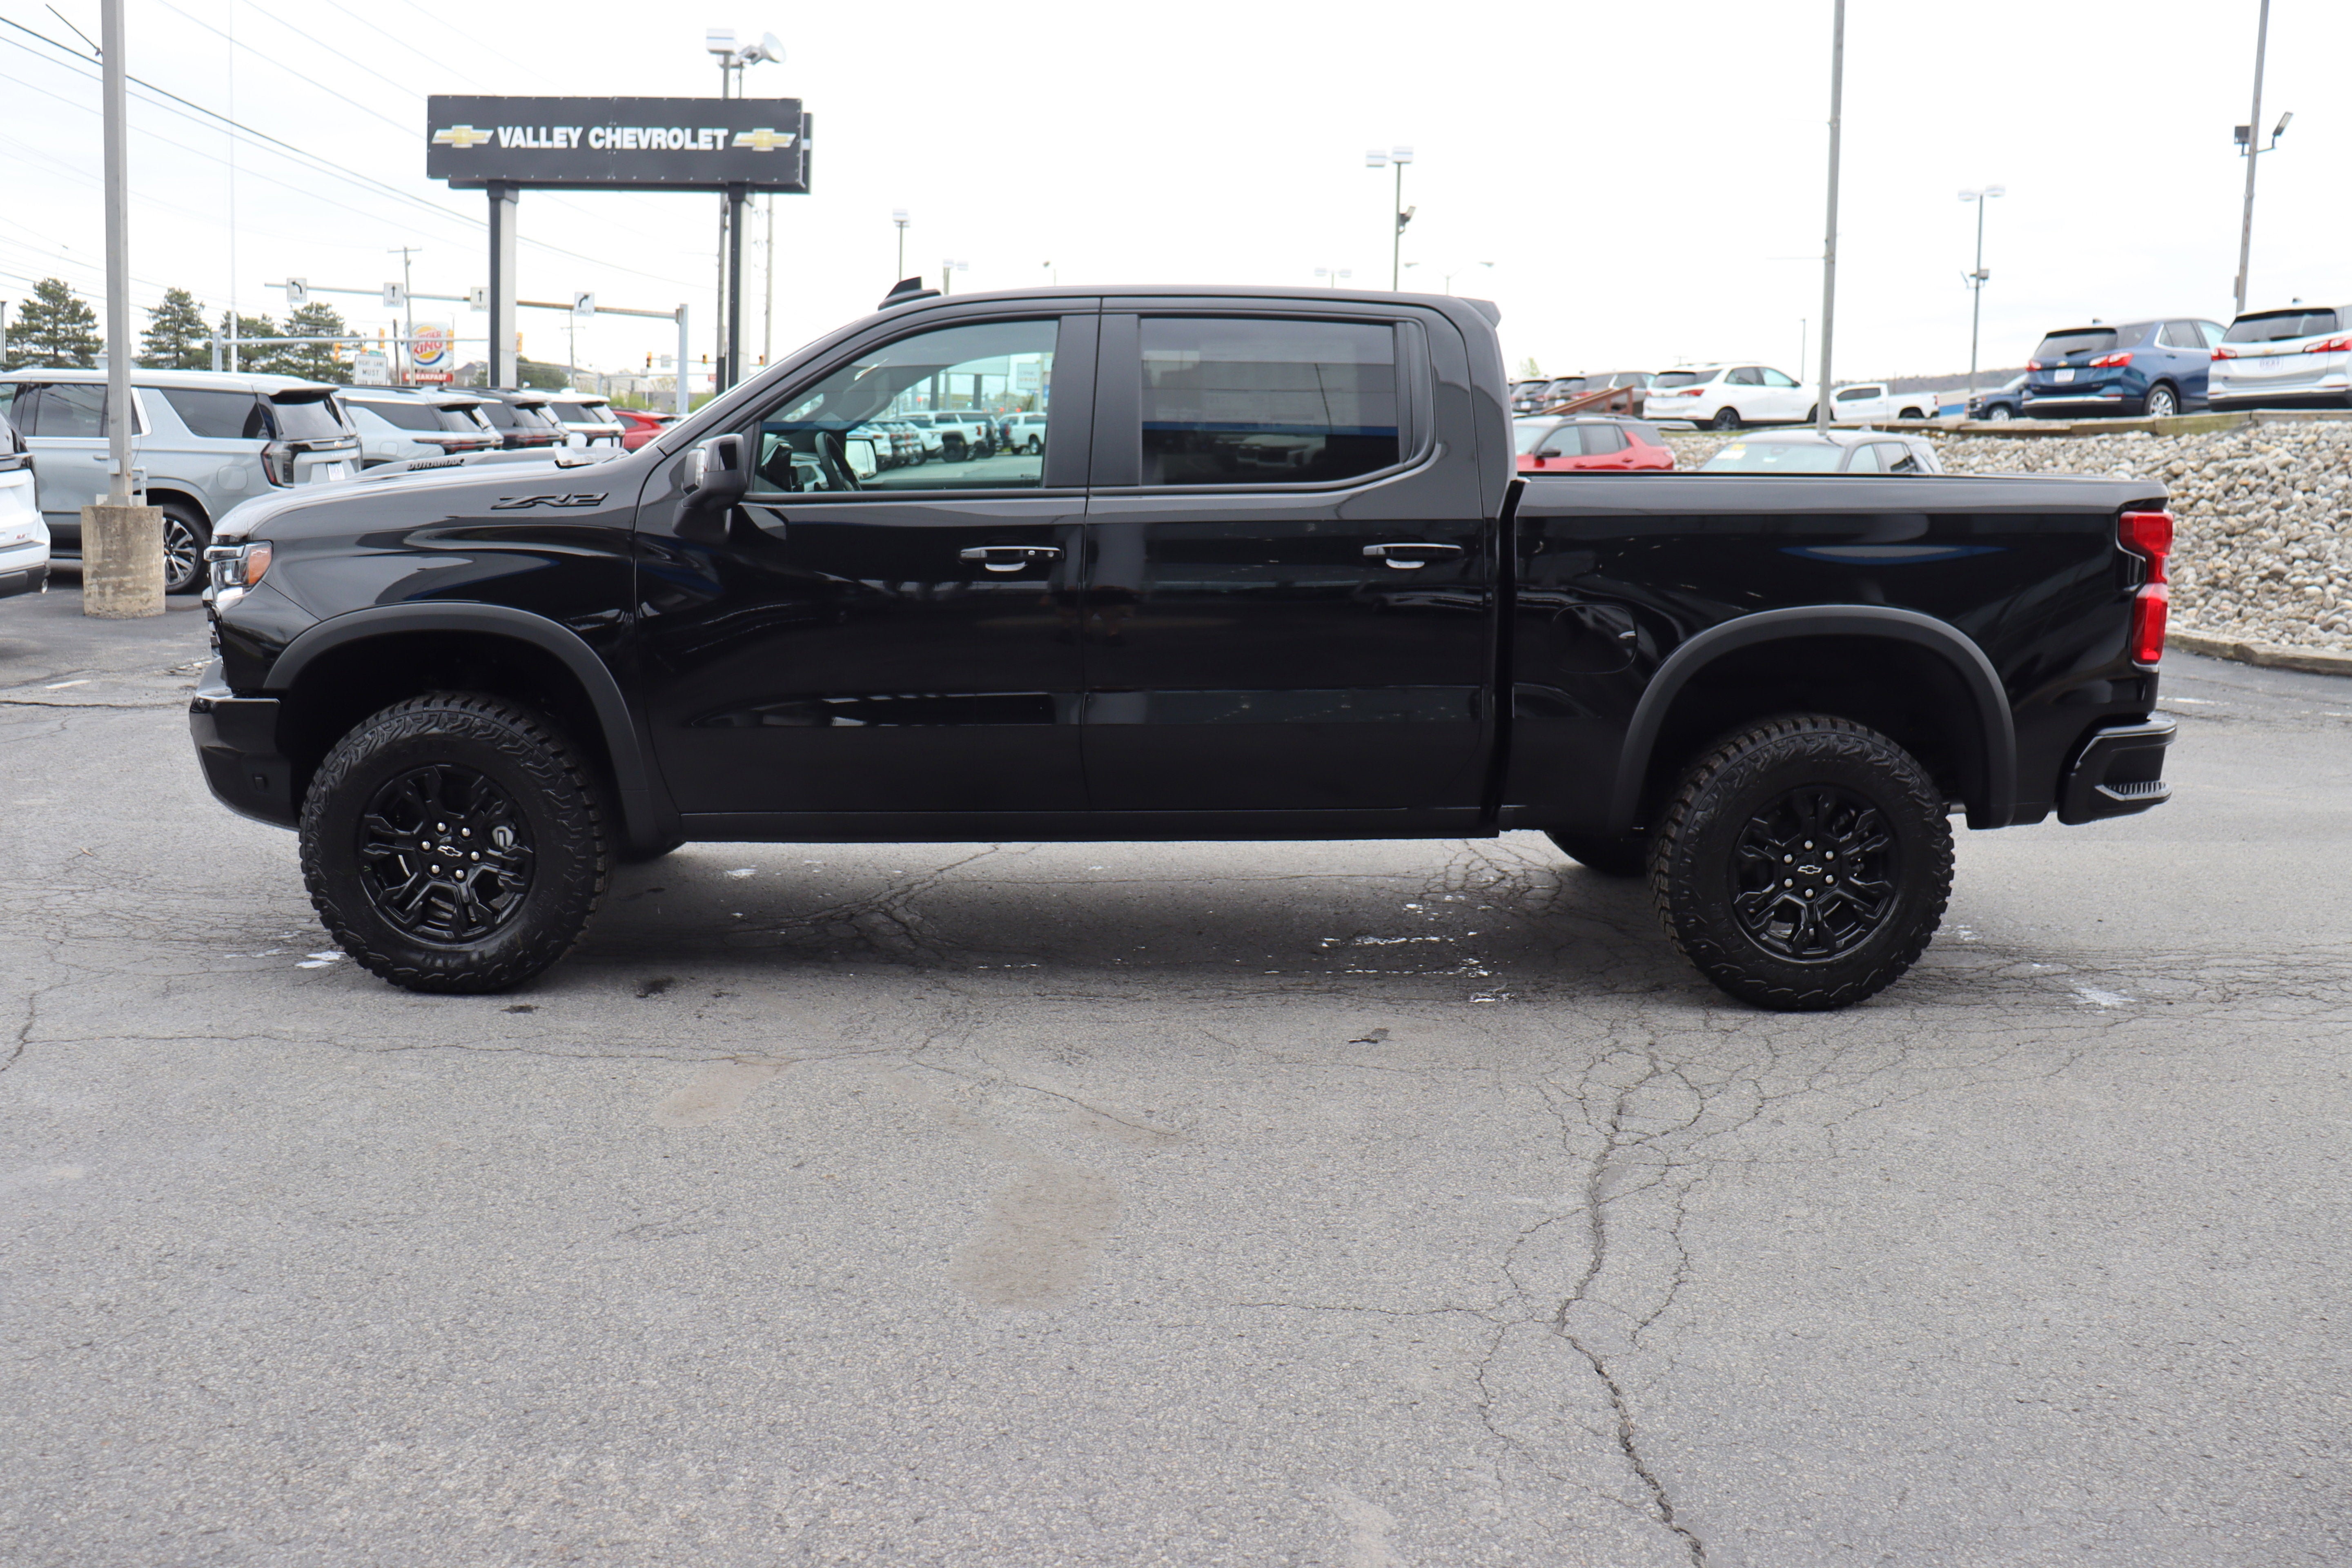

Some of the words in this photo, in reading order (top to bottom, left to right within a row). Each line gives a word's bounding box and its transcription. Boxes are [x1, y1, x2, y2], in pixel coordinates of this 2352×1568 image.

[497, 126, 583, 149] VALLEY
[588, 127, 728, 151] CHEVROLET
[414, 339, 443, 354] KING
[490, 492, 609, 510] ZR2
